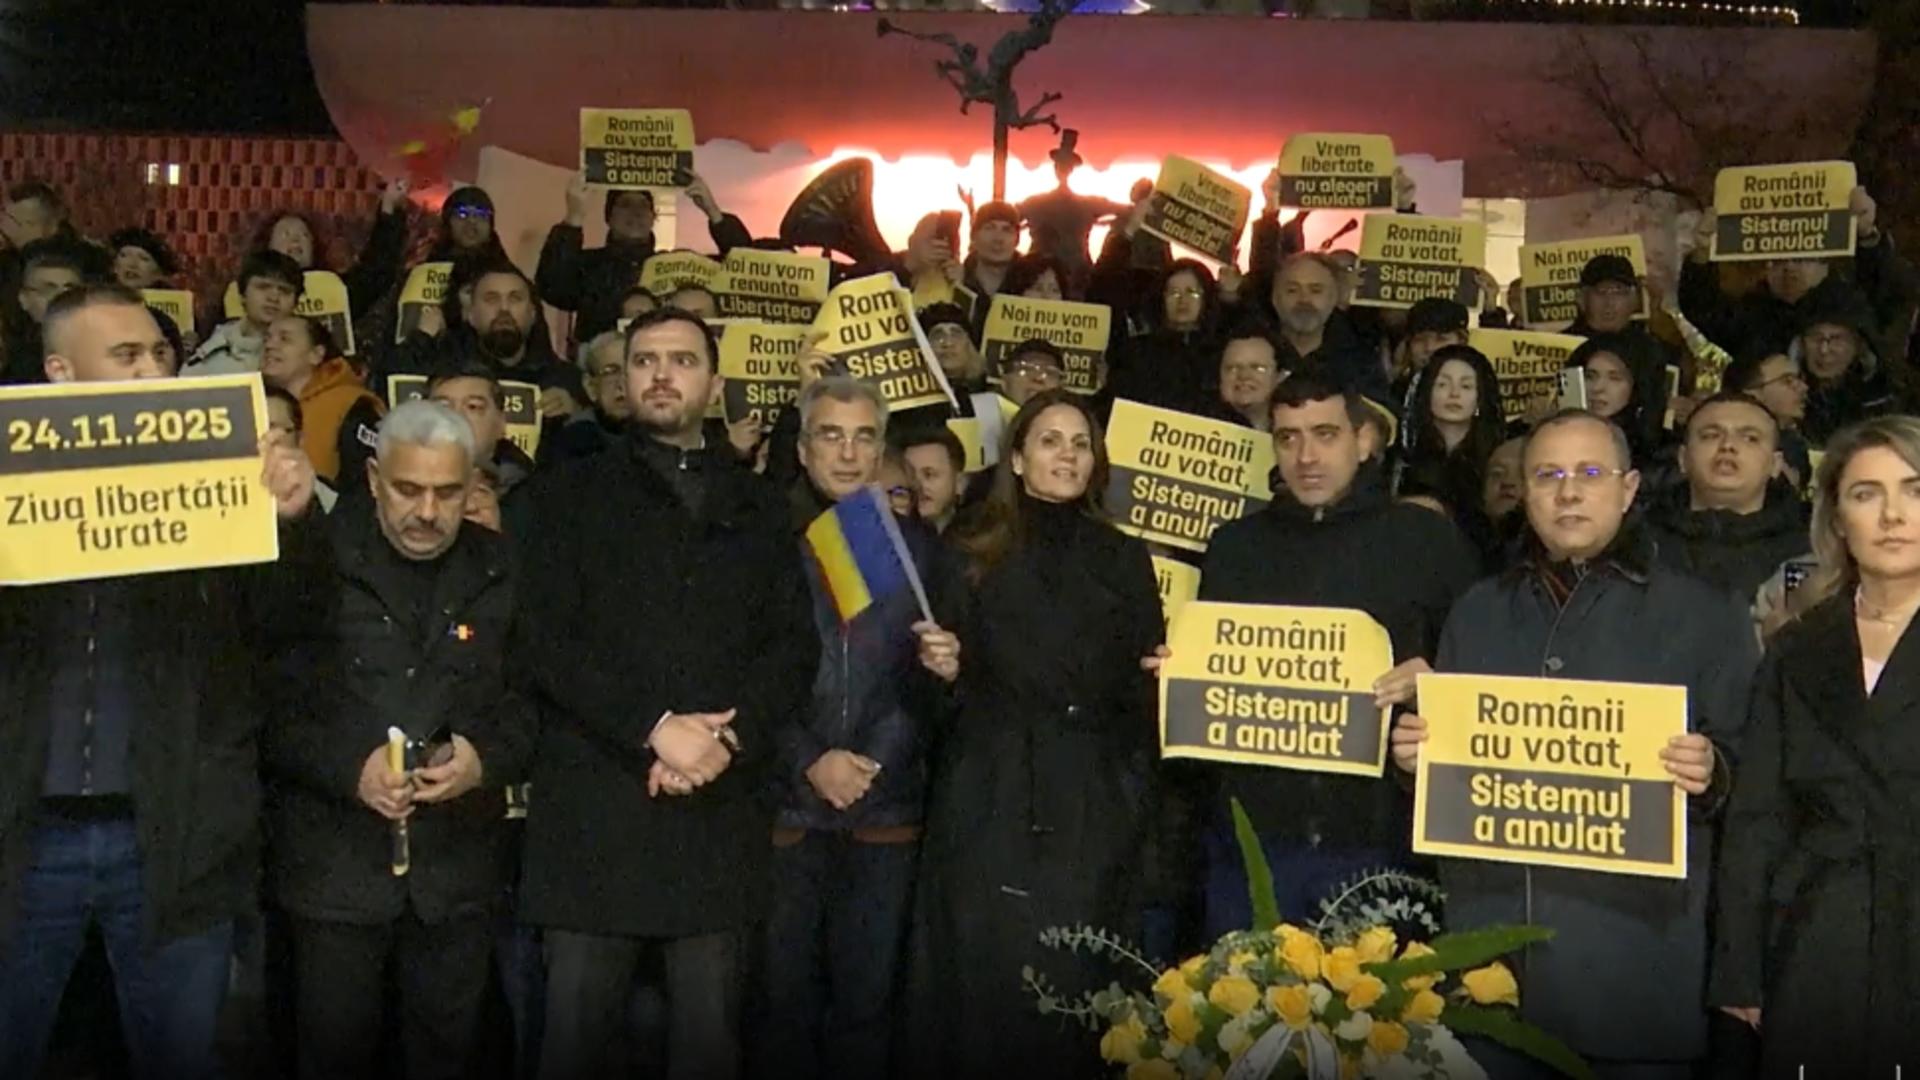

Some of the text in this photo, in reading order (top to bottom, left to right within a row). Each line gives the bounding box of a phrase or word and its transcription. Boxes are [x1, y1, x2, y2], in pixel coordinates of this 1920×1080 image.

[607, 116, 675, 132] Românii
[604, 133, 679, 149] au votat,
[1315, 141, 1362, 157] Vrem
[604, 151, 678, 169] Sistemul
[1301, 156, 1375, 173] libertate
[606, 168, 675, 185] a anulat
[1295, 177, 1379, 197] nu alegeri
[1744, 170, 1827, 193] Românii
[1163, 201, 1186, 219] nu
[1740, 191, 1830, 210] au votat,
[1386, 223, 1463, 245] Românii
[1740, 213, 1829, 235] Sistemul
[1742, 232, 1825, 252] a anulat
[1380, 244, 1464, 265] au votat,
[1533, 249, 1564, 268] Noi
[1566, 246, 1590, 263] nu
[749, 260, 771, 278] nu
[774, 263, 815, 282] vom
[1379, 264, 1461, 288] Sistemul
[1380, 284, 1393, 300] a
[719, 296, 813, 320] Libertatea
[1000, 303, 1099, 330] Noi nu vom
[839, 320, 872, 346] au
[1512, 339, 1568, 358] Vrem
[746, 359, 771, 376] au
[7, 405, 233, 453] 24.11.2025
[1150, 420, 1254, 463] Românii
[1138, 446, 1250, 494] au votat,
[4, 475, 250, 527] Ziua libertății
[1131, 475, 1246, 520] Sistemul
[1130, 504, 1147, 526] a
[76, 515, 190, 554] furate
[1215, 618, 1347, 653] Românii
[1206, 652, 1351, 690] au votat,
[1205, 686, 1349, 726] Sistemul
[1477, 692, 1625, 733] Românii
[1207, 721, 1343, 757] a anulat
[1469, 732, 1632, 777] au votat,
[1470, 773, 1631, 820] Sistemul
[1473, 814, 1627, 855] a anulat
